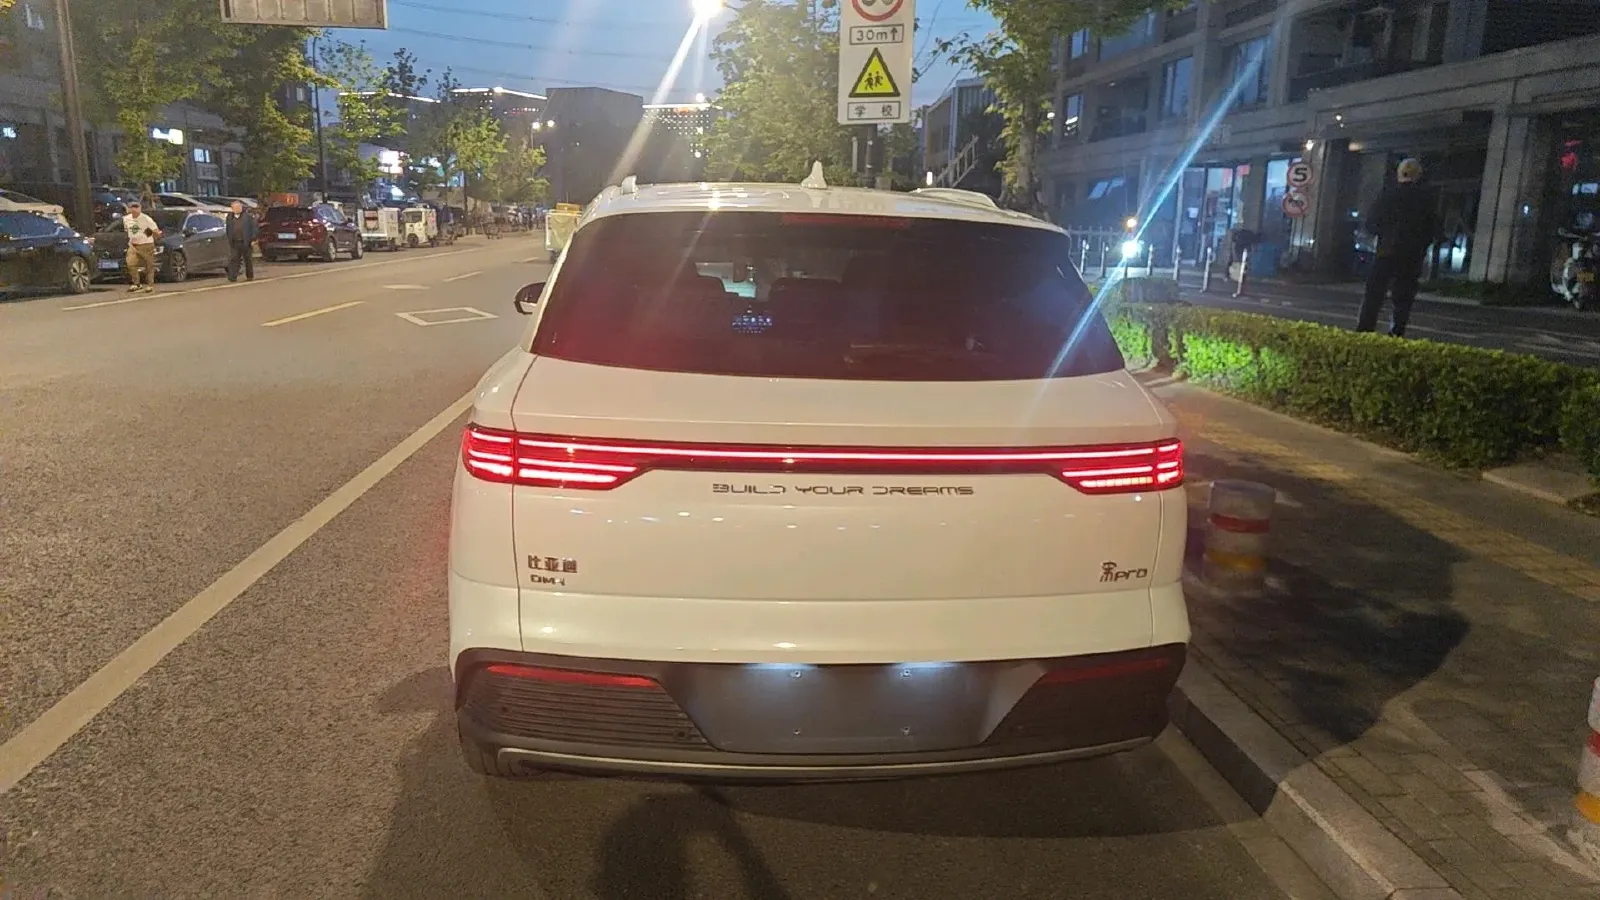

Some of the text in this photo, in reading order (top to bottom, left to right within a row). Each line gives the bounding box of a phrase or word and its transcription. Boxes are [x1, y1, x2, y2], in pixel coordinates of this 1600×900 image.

[856, 29, 888, 42] 30m
[854, 104, 893, 118] 学校
[1293, 167, 1308, 183] 5
[712, 483, 975, 496] BUILD YOUR DREAMS
[527, 554, 578, 573] 比亚迪
